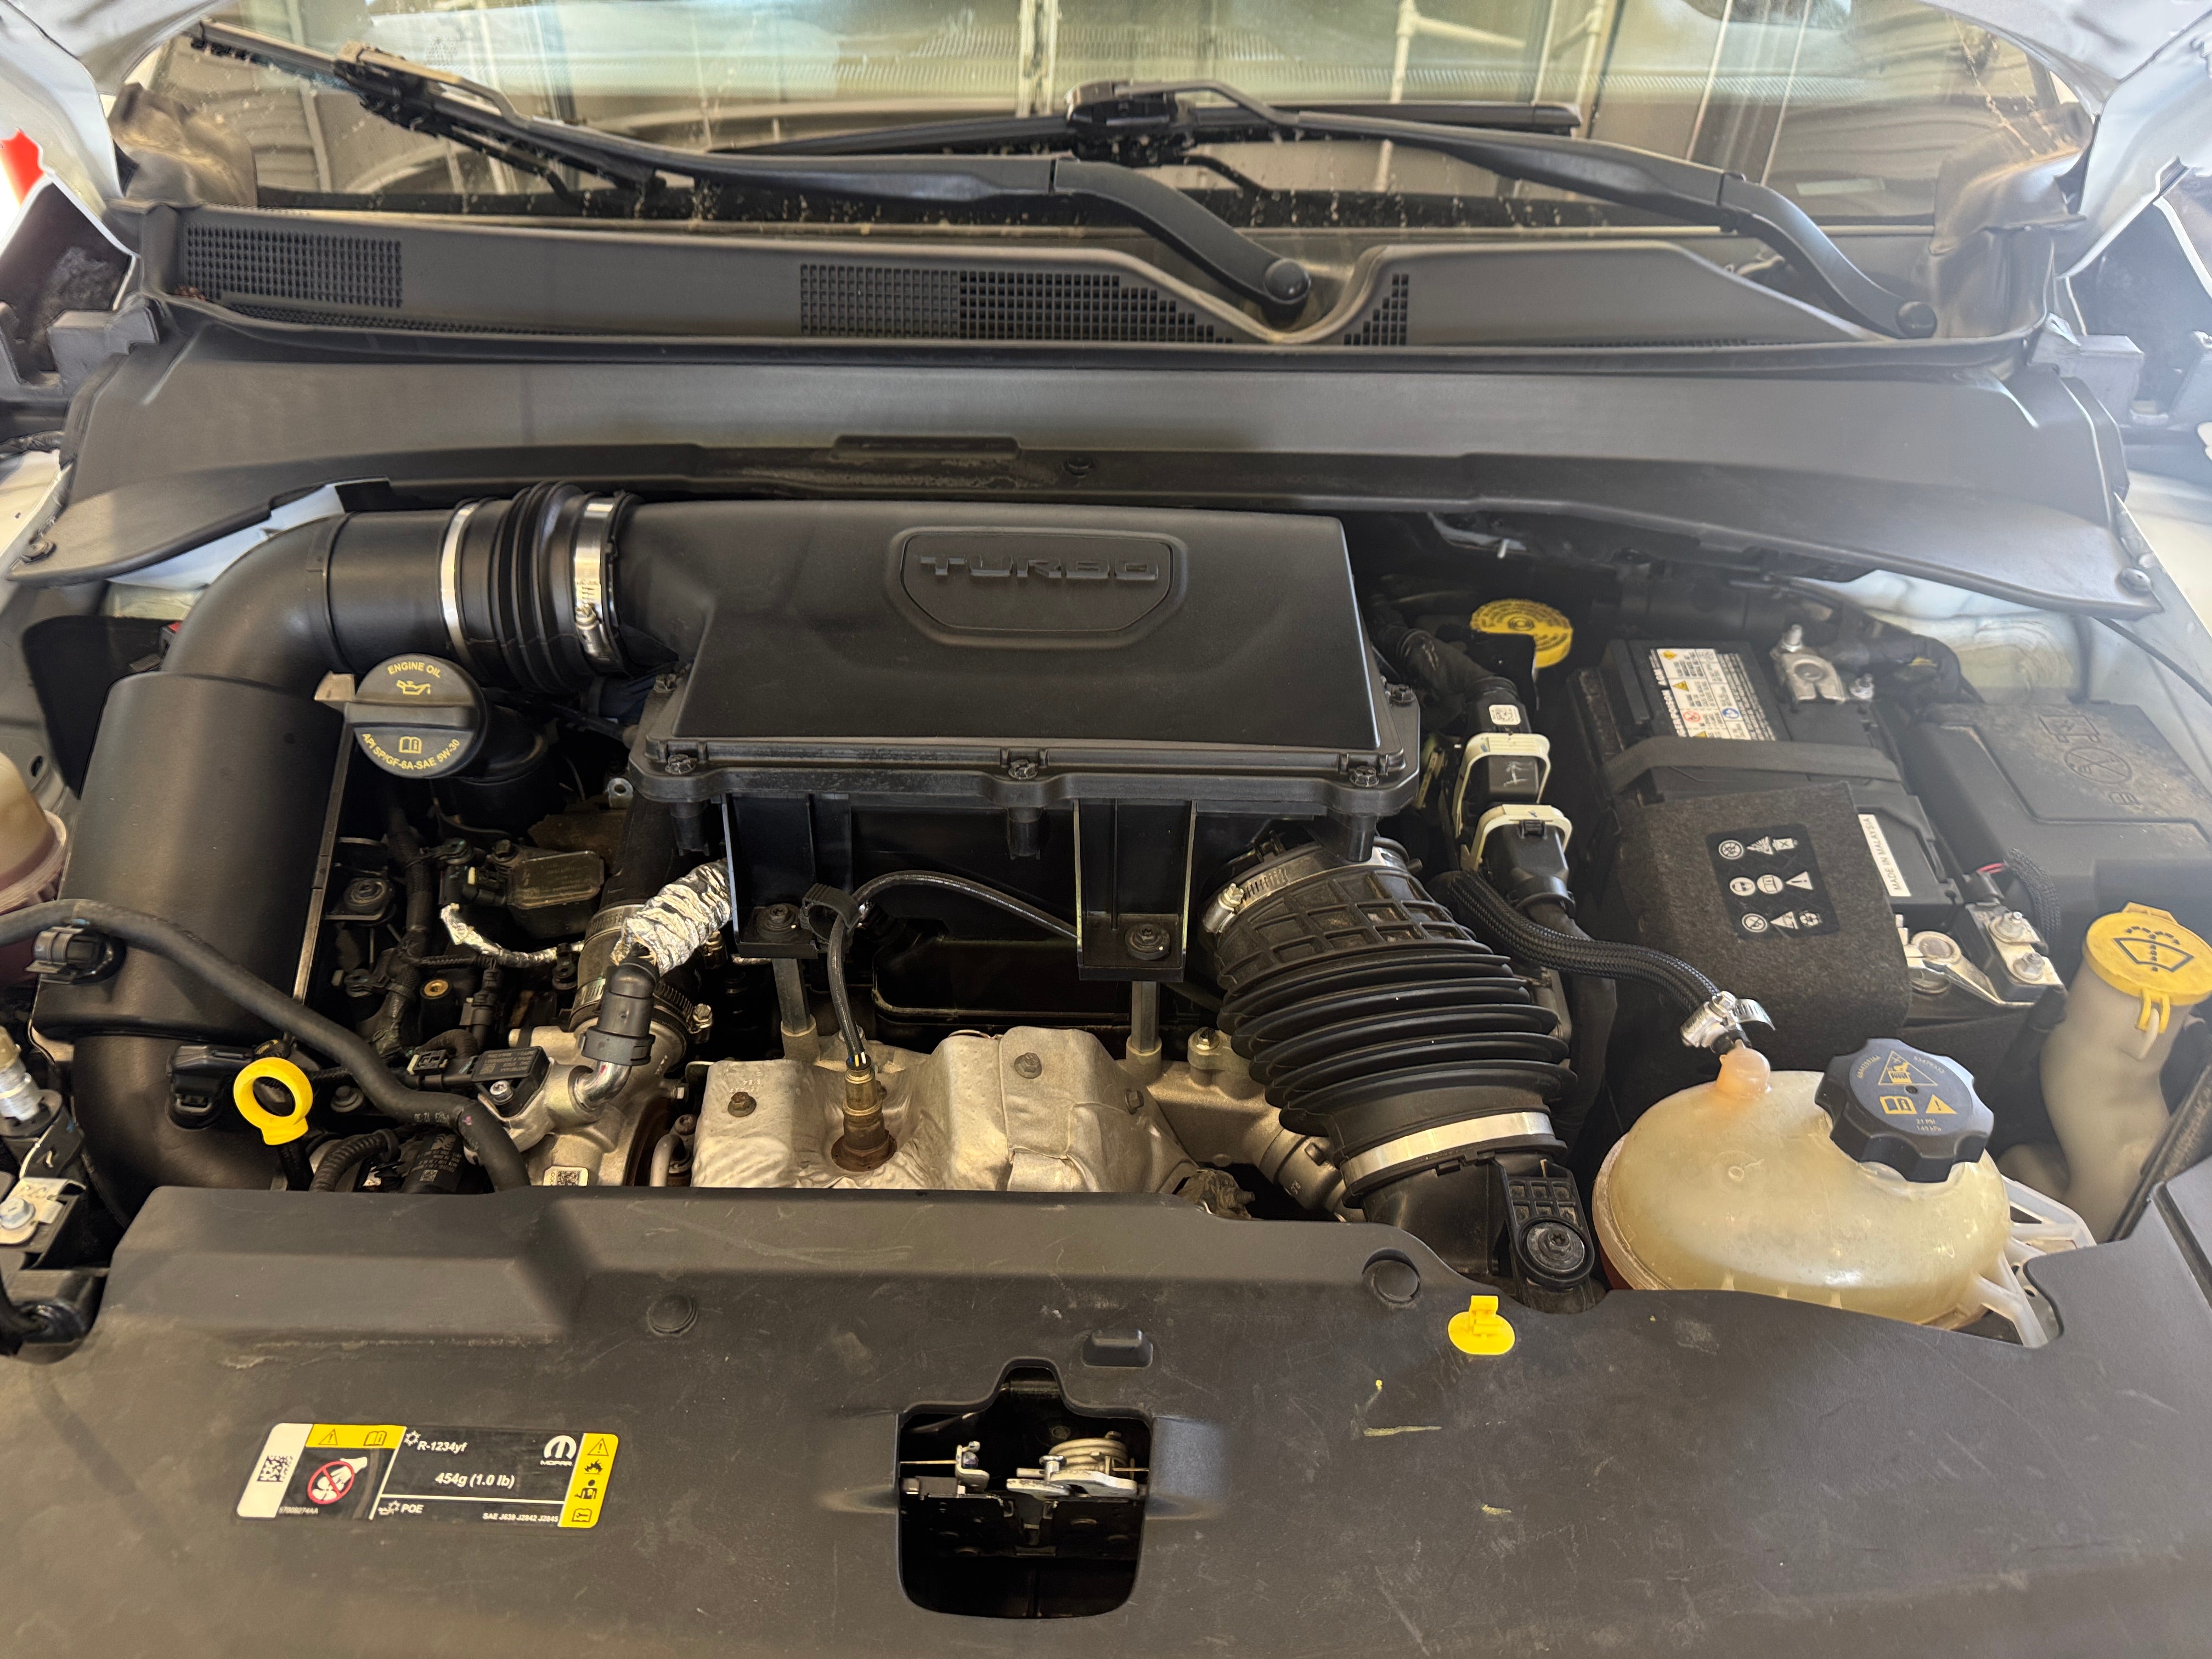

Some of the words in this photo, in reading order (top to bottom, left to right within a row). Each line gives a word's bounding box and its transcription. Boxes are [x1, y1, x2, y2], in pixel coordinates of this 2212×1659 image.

[919, 554, 1159, 582] TURBO
[387, 661, 425, 675] ENGINE
[426, 664, 441, 678] OIL
[362, 733, 376, 749] API
[436, 738, 460, 763] 5W-30
[1863, 817, 1886, 855] MALAYSIA
[1881, 856, 1891, 865] IN
[1884, 867, 1902, 890] MADE
[417, 1441, 467, 1454] R-1234yf
[435, 1472, 467, 1488] 454g
[469, 1474, 495, 1488] (1.0
[496, 1475, 515, 1489] lb)
[401, 1504, 424, 1514] POE
